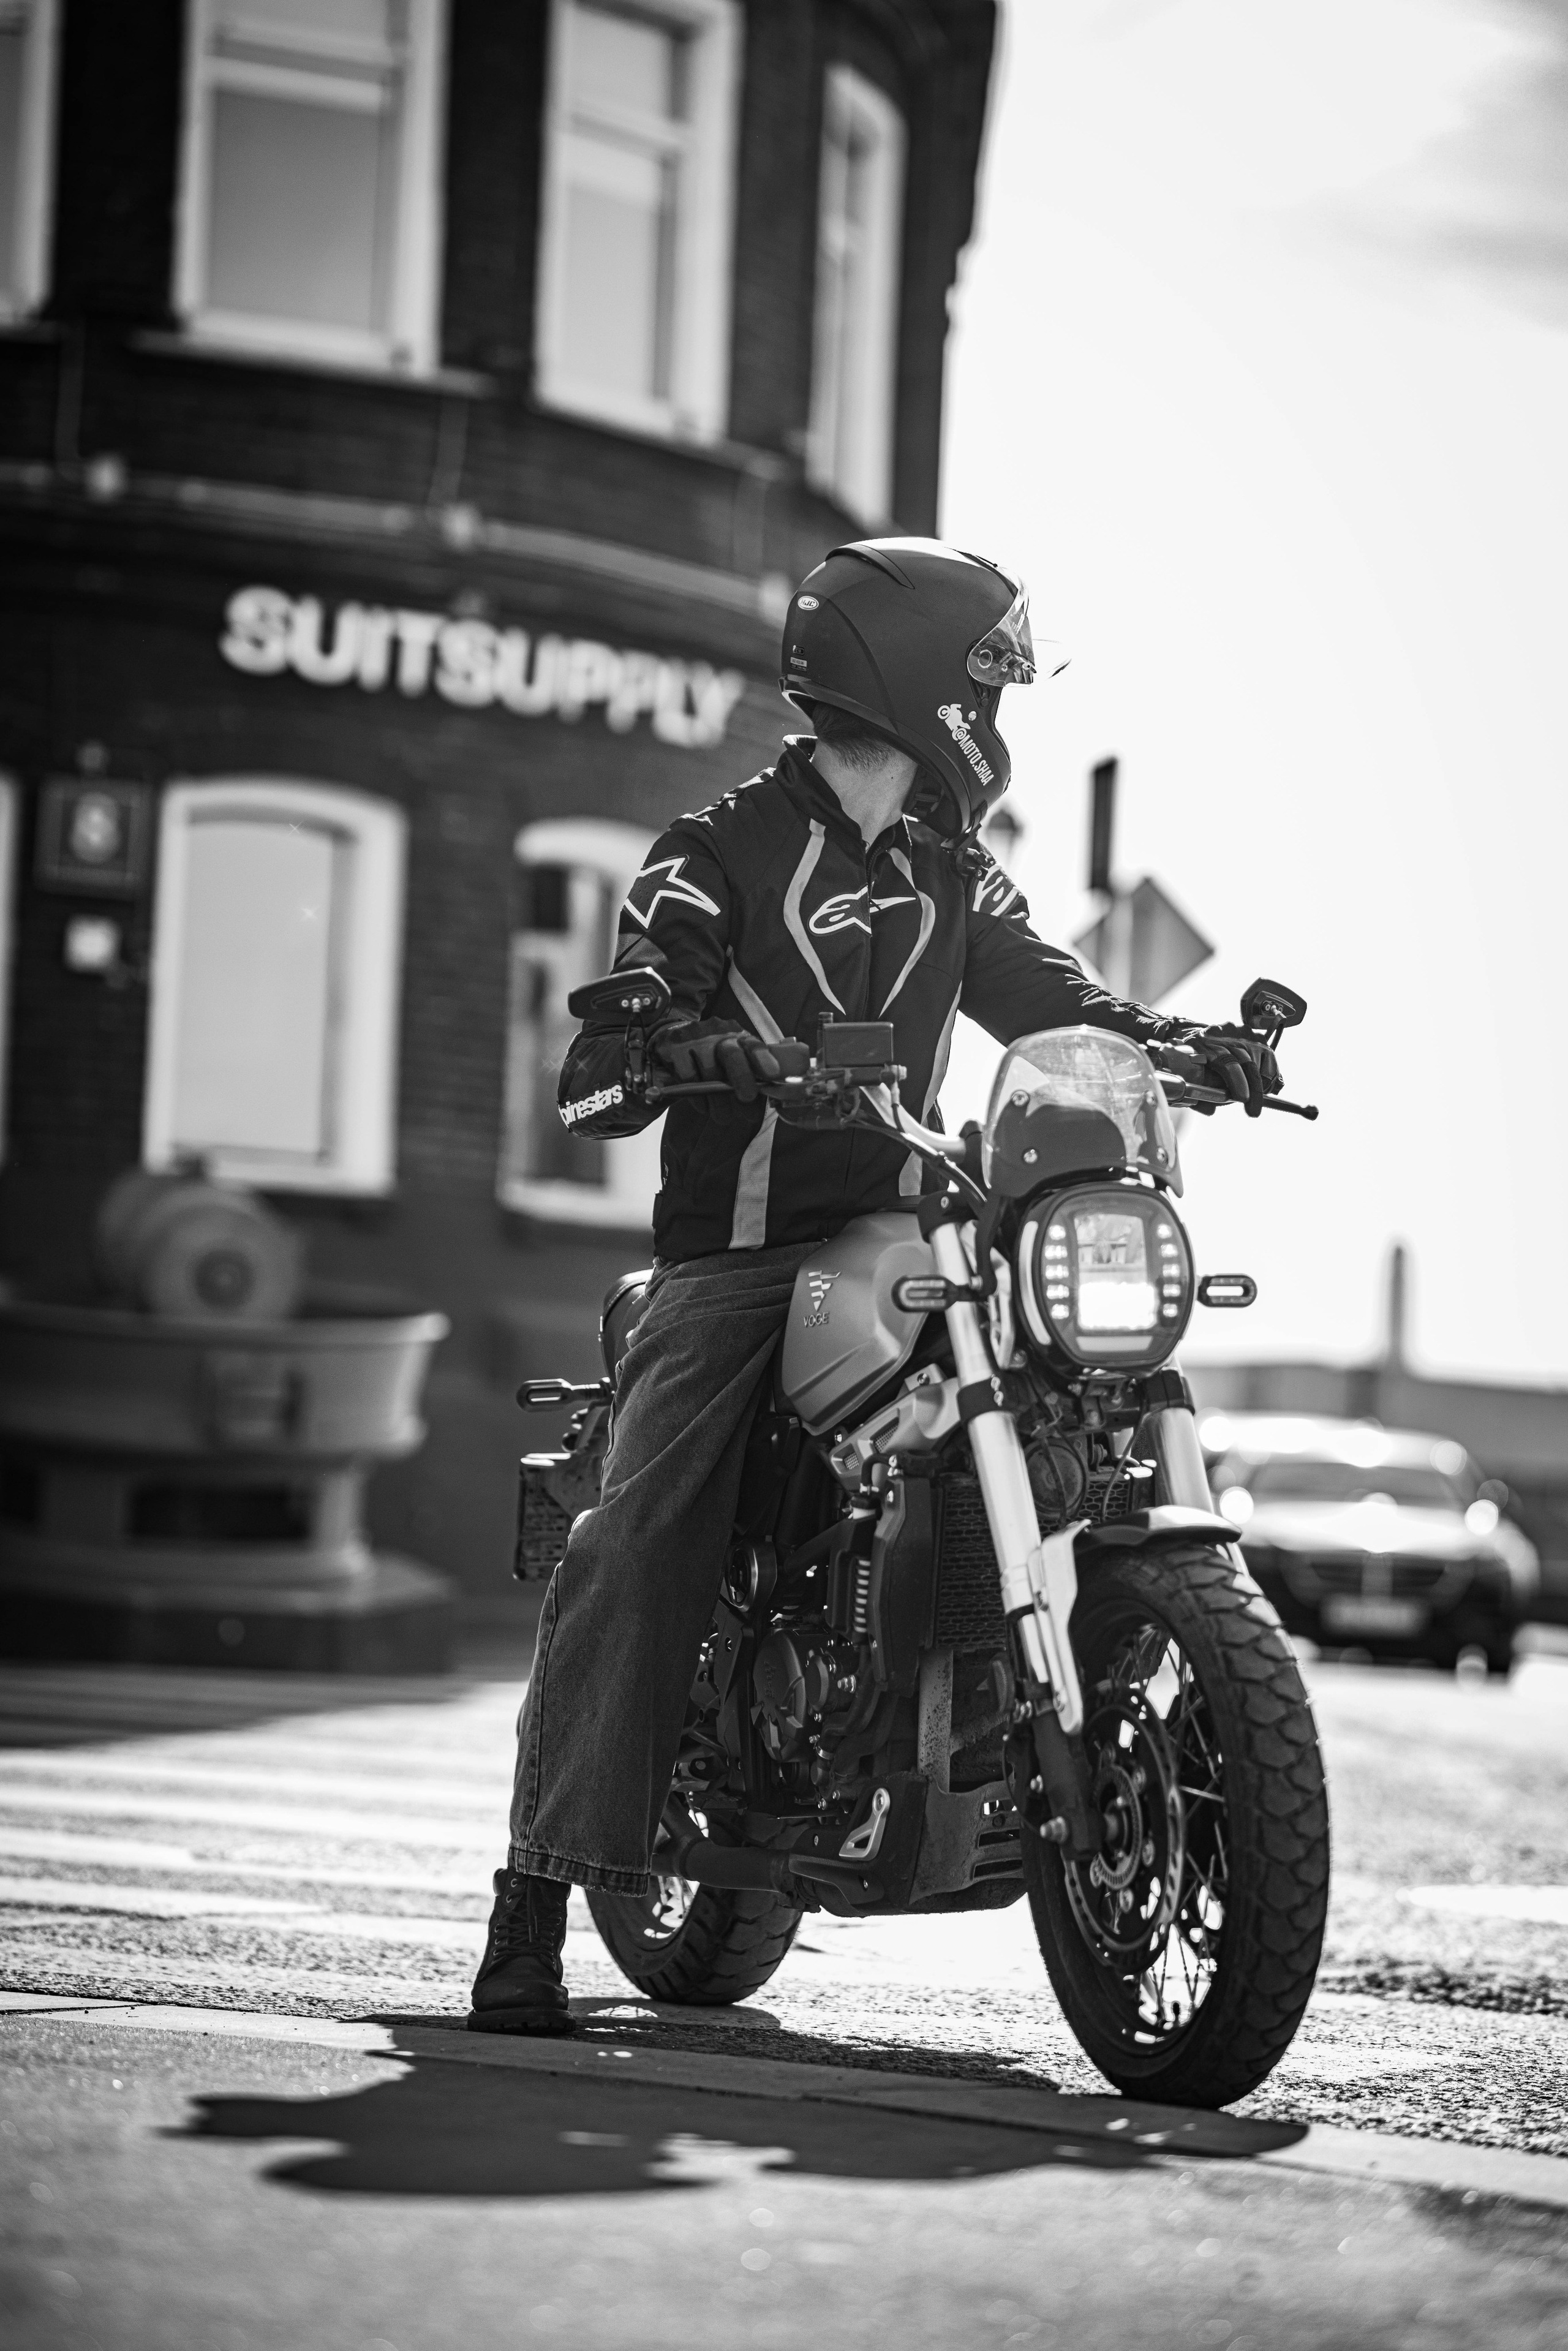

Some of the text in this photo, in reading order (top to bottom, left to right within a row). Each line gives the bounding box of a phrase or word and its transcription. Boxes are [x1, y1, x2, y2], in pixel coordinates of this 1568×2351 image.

[799, 598, 815, 607] HJC
[221, 585, 745, 747] SUITSUPPLY
[952, 728, 994, 786] @MOTO.SHAA
[804, 1312, 829, 1327] VOGE
